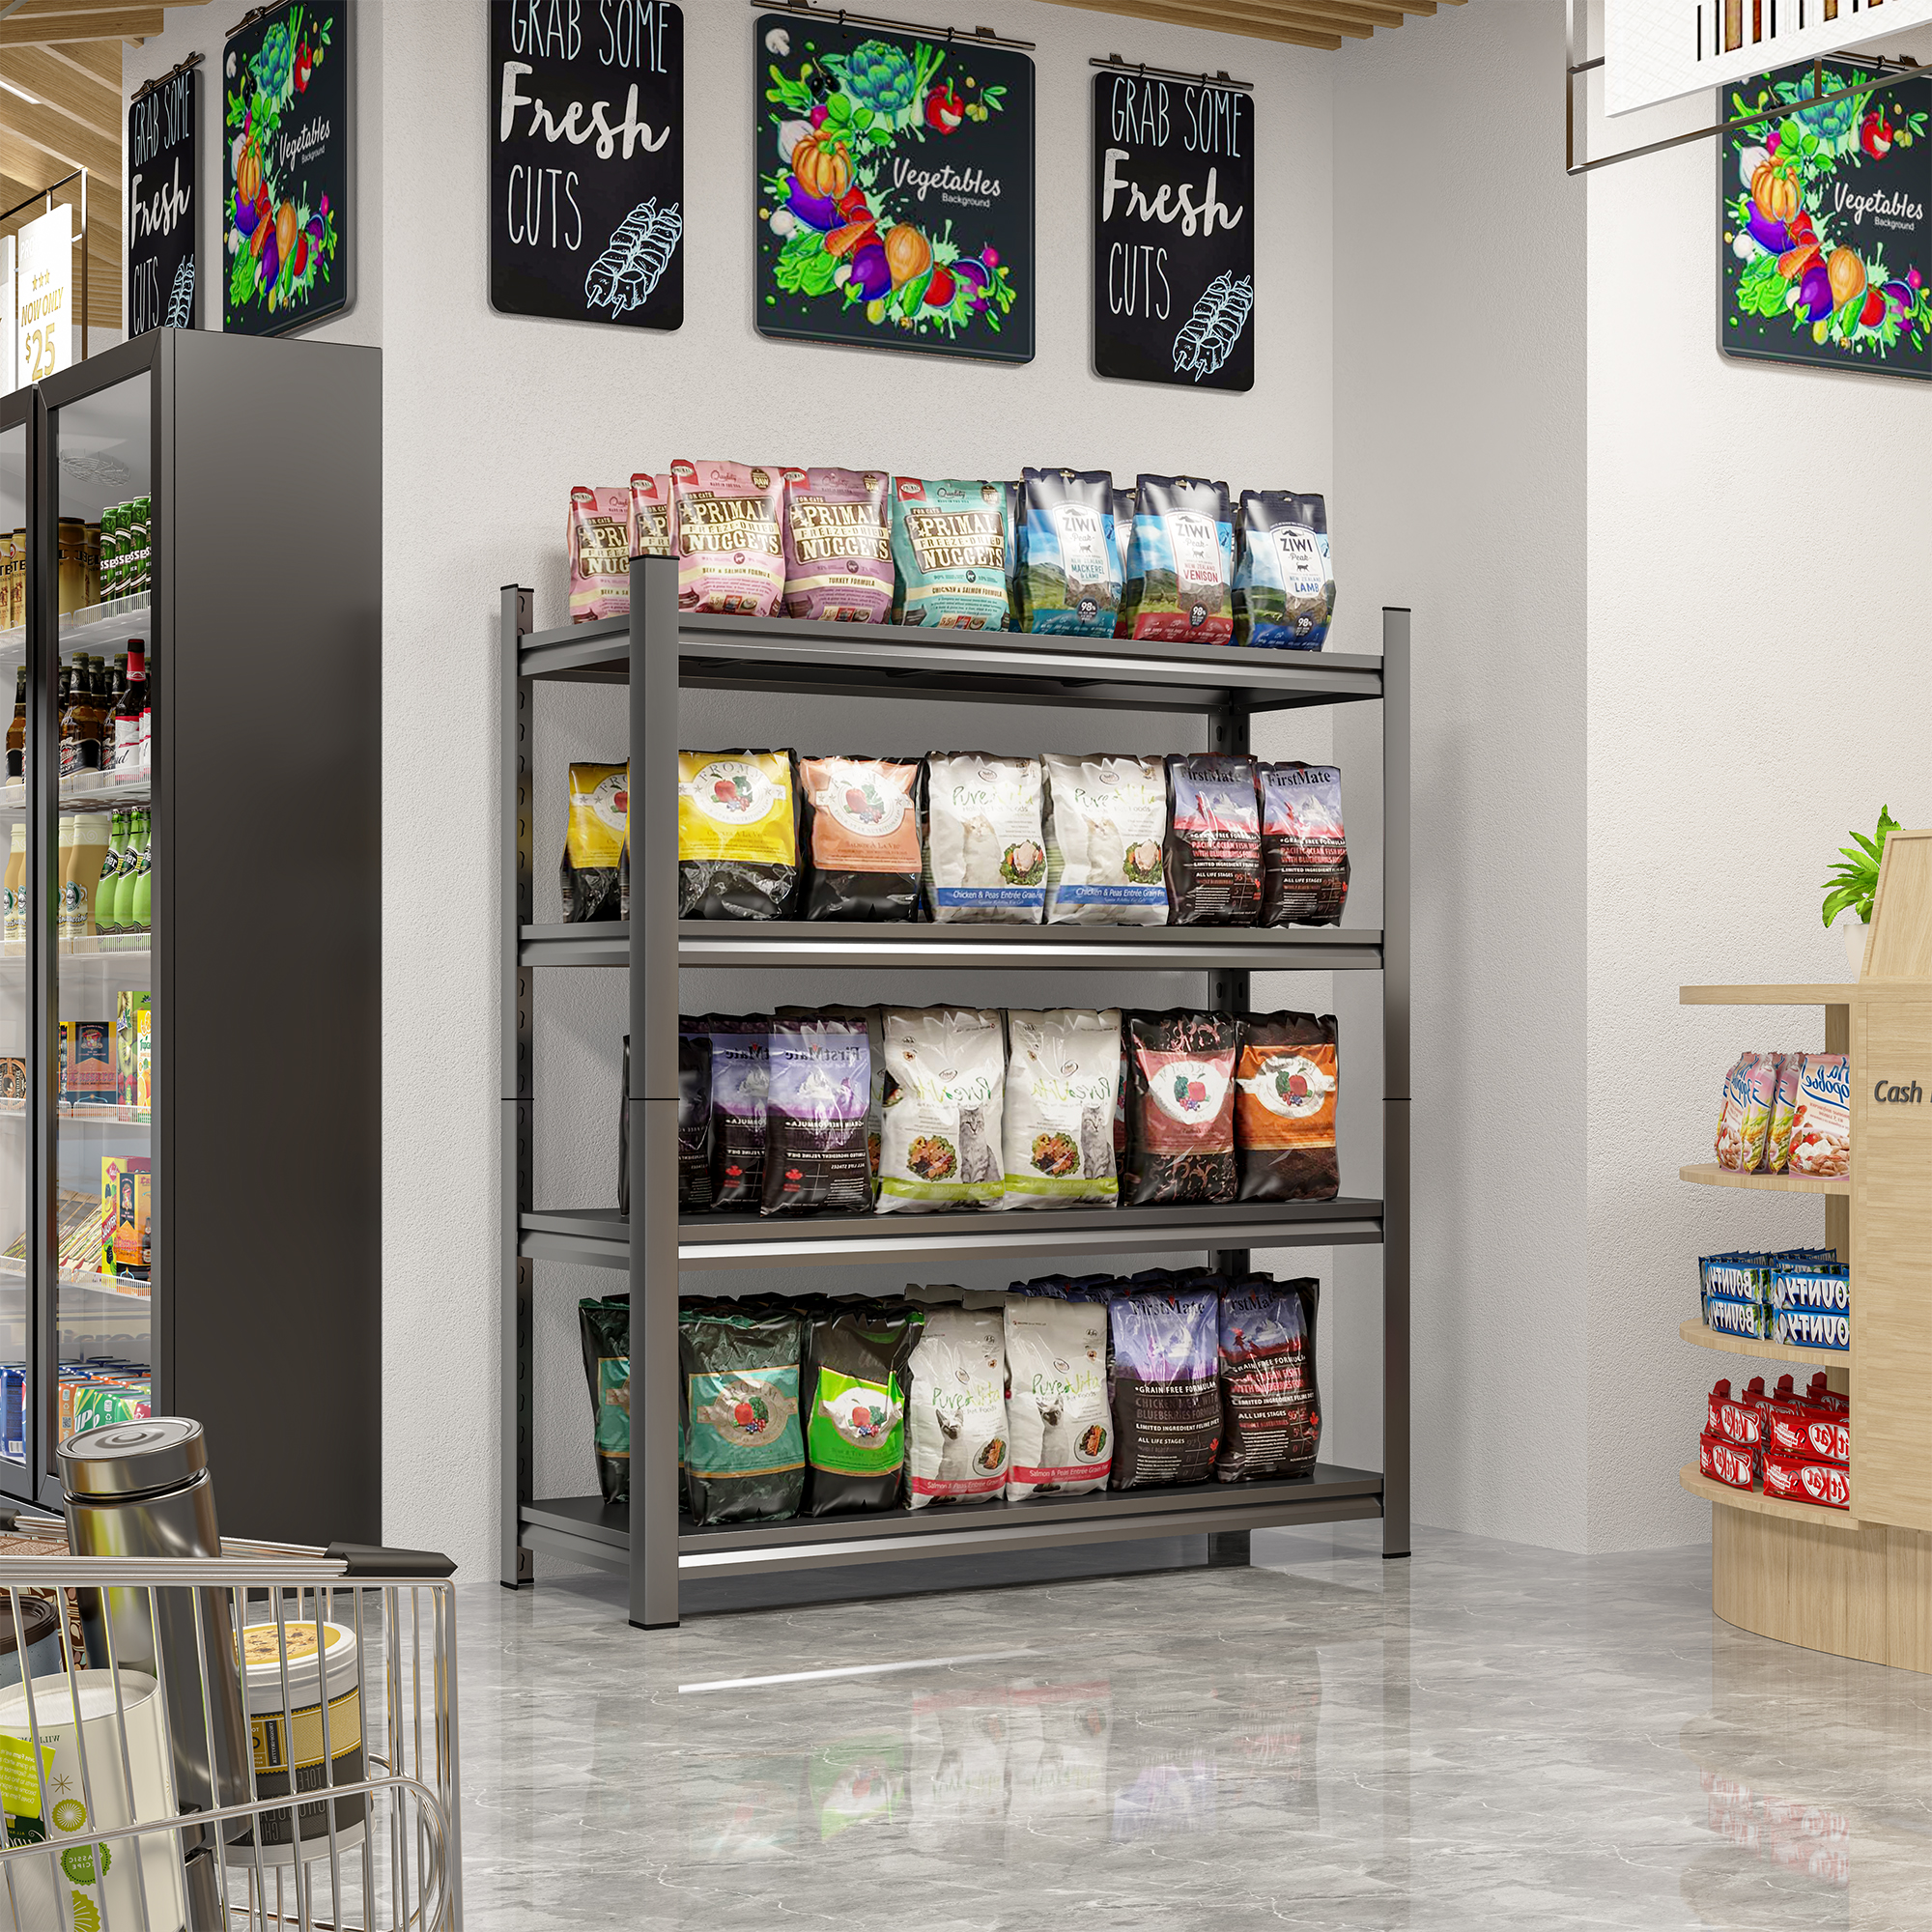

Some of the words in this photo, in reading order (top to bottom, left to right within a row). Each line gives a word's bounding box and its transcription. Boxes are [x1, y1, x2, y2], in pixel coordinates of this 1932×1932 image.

[511, 0, 582, 61] GRAB
[599, 0, 670, 73] SOME
[134, 91, 158, 167] GRAB
[163, 71, 190, 150] SOME
[500, 61, 670, 159] Fresh
[1112, 76, 1169, 147] GRAB
[1184, 87, 1243, 157] SOME
[279, 116, 330, 171] Vegetables
[301, 146, 326, 164] Background
[893, 157, 1001, 200] Vegetables
[131, 156, 191, 249] Fresh
[942, 193, 991, 208] Background
[1103, 148, 1243, 237] Fresh
[508, 164, 582, 251] CUTS
[1833, 182, 1923, 225] Vegetables
[1874, 216, 1915, 231] Background
[1109, 242, 1170, 320] CUTS
[133, 256, 158, 335] CUTS
[21, 298, 42, 327] NOW
[43, 287, 64, 316] ONLY
[25, 322, 56, 382] $25
[694, 500, 769, 525] PRIMAL
[804, 505, 880, 526] PRIMAL
[922, 514, 998, 537] PRIMAL
[1064, 517, 1096, 532] ZIWI
[1176, 523, 1209, 540] ZIWI
[594, 526, 628, 548] PRI
[689, 531, 779, 554] NUGGETS
[1280, 538, 1313, 553] ZIWI
[802, 536, 889, 560] NUGGETS
[922, 546, 1003, 569] NUGGETS
[1291, 552, 1309, 562] Peak
[1071, 563, 1105, 575] MACKEREL
[1183, 569, 1218, 582] VENISON
[982, 588, 1002, 597] FORMULA
[1294, 582, 1320, 593] LAMB
[699, 761, 763, 781] FROMM
[1267, 770, 1331, 786] FirstMate
[953, 890, 977, 899] Chicken
[1001, 890, 1021, 899] Entrée
[1076, 888, 1102, 896] Chicken
[1124, 889, 1142, 897] Entrée
[1143, 889, 1155, 898] Grain
[1874, 1080, 1922, 1103] Cash
[1131, 1298, 1206, 1316] FirstMate
[1166, 1385, 1183, 1394] FREE
[1185, 1382, 1213, 1393] FORMULA
[1264, 1396, 1293, 1405] INGREDIENT
[1137, 1409, 1190, 1420] BLUEBERRIES
[1136, 1423, 1161, 1432] LIMITED
[1162, 1423, 1196, 1432] INGREDIENT
[1030, 1469, 1050, 1478] Salmon
[1070, 1467, 1088, 1476] Entrée
[927, 1481, 947, 1490] Salmon
[968, 1480, 985, 1489] Entrée
